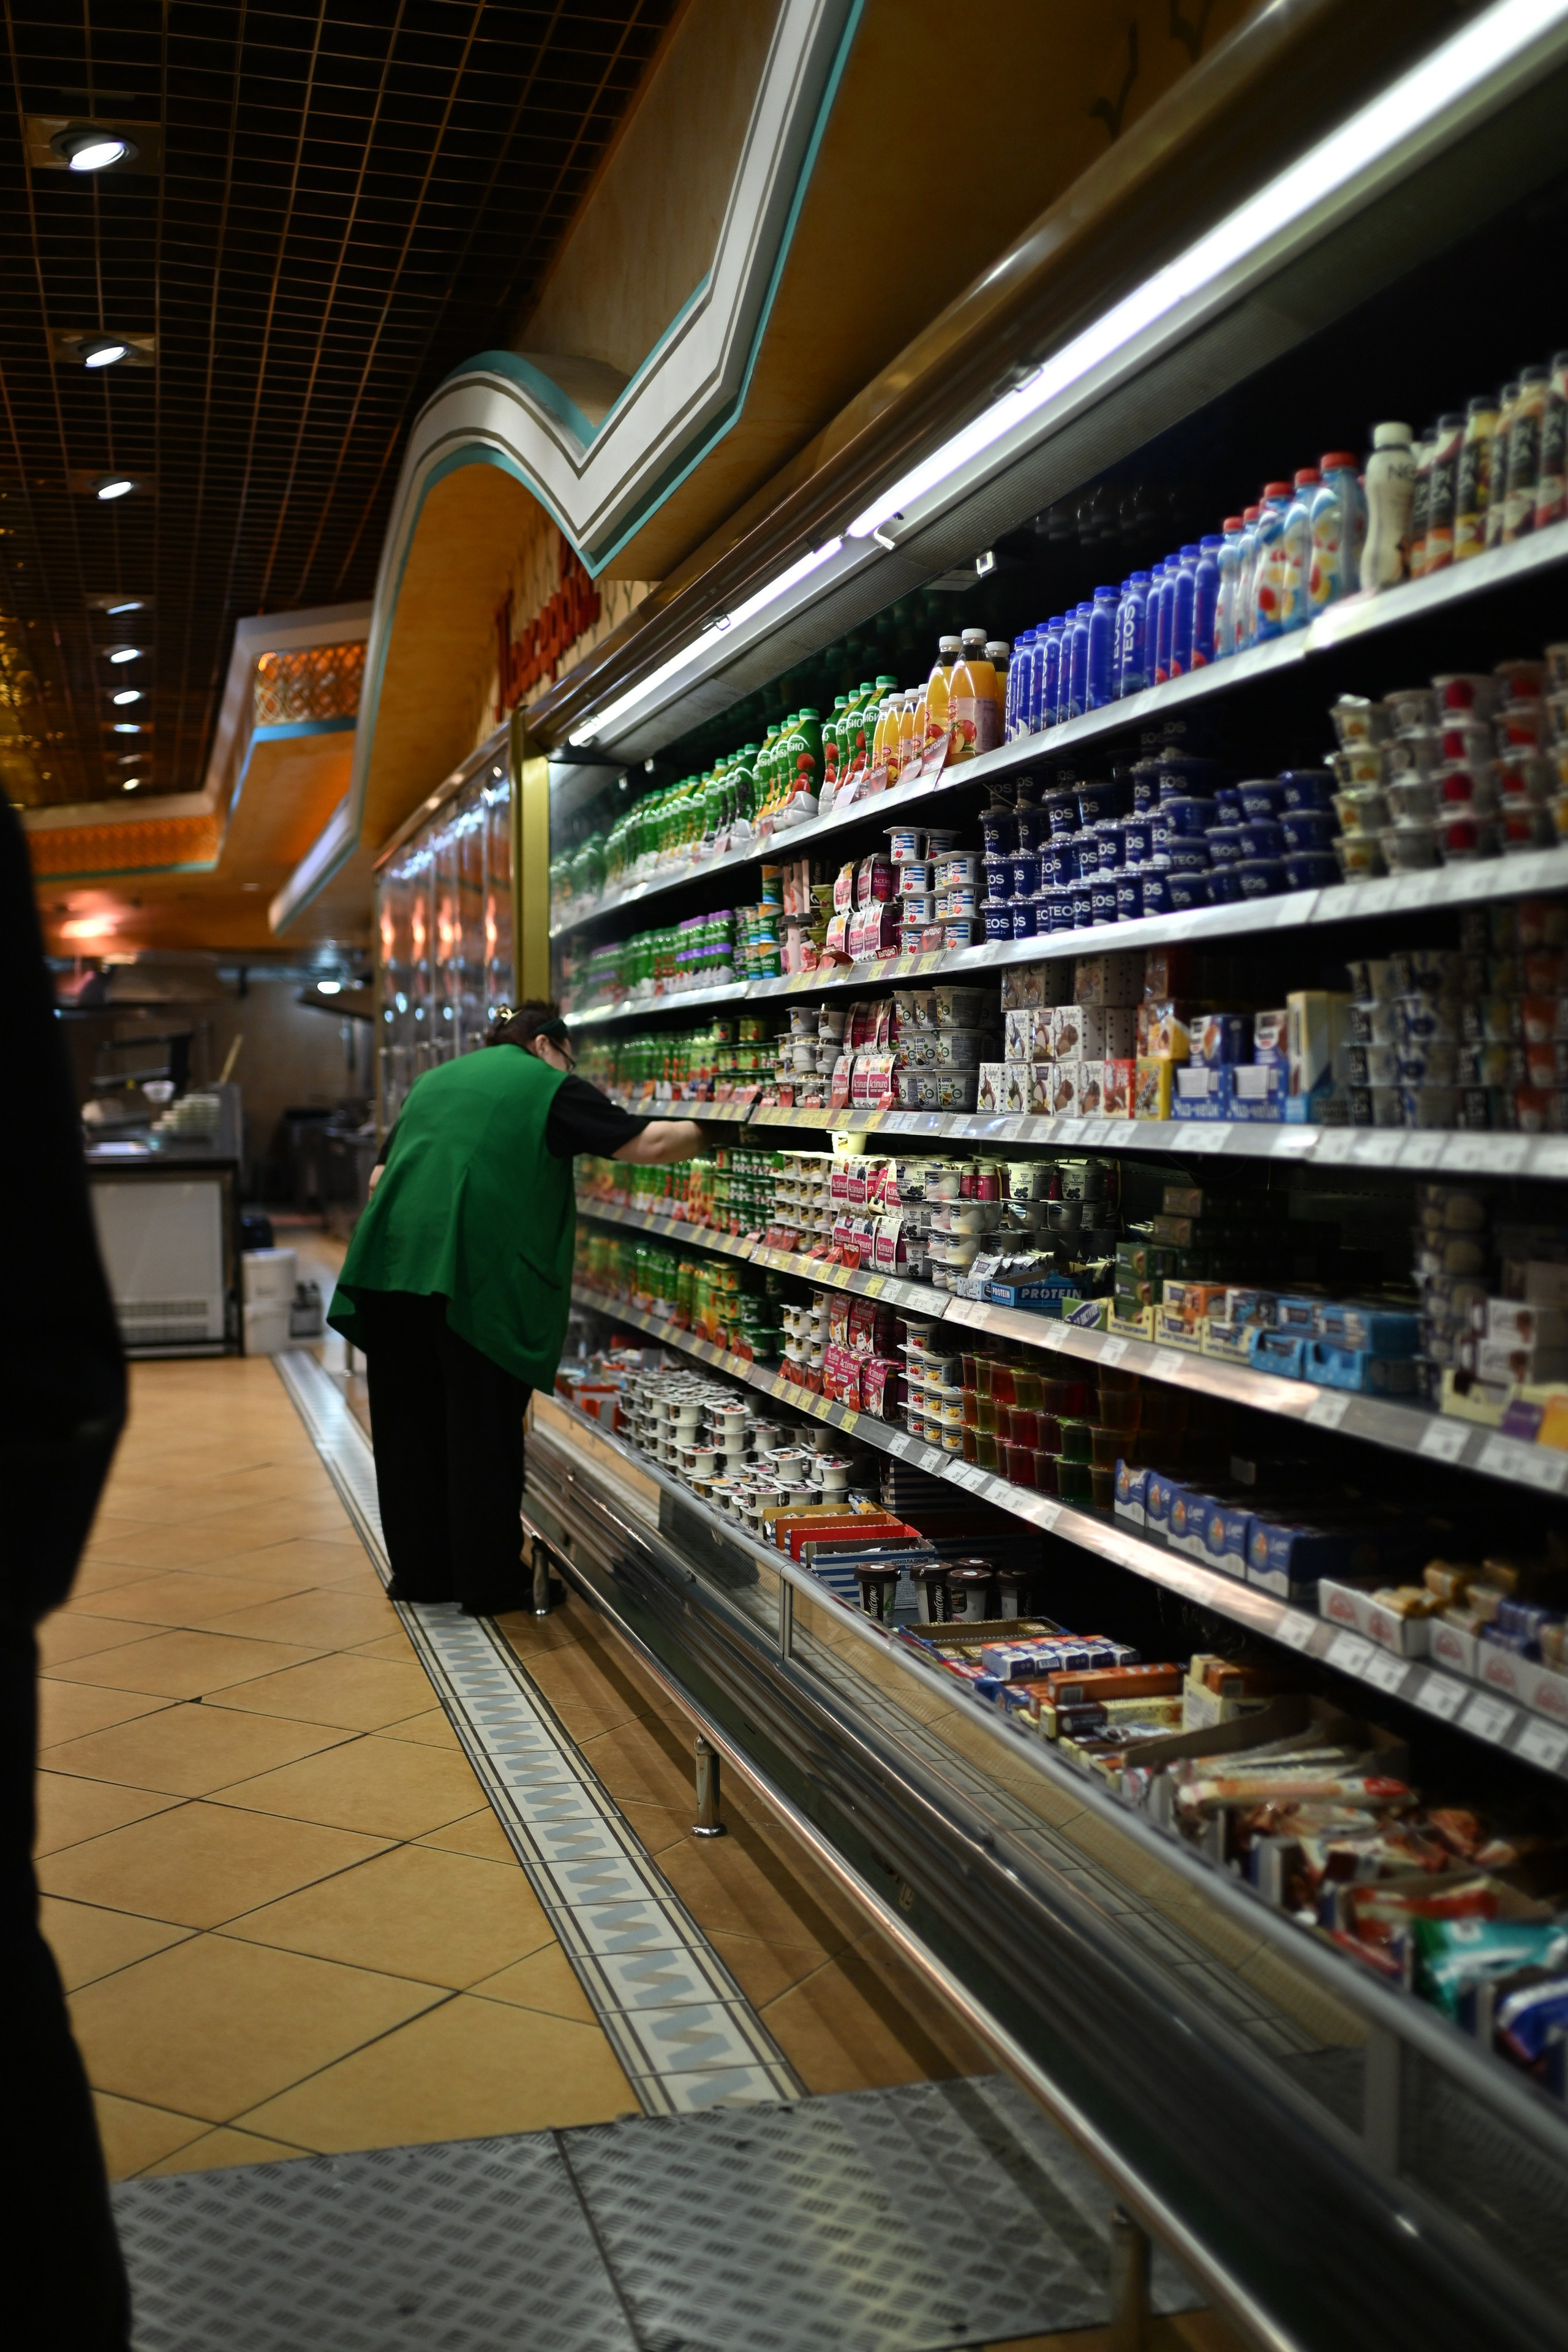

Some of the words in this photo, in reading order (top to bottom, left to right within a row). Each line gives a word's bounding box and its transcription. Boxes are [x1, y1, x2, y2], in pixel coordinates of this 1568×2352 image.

[1123, 603, 1135, 662] TEOS
[924, 735, 947, 757] ВЫГОДНО
[1160, 776, 1188, 788] EOS
[1049, 808, 1074, 819] EOS
[1092, 895, 1115, 907] EOS
[1048, 905, 1074, 917] TEO
[986, 918, 1009, 929] EOS
[1013, 916, 1026, 927] OS
[924, 927, 941, 936] ВЫГОДНО
[878, 949, 895, 958] ВЫГОДНО
[854, 1079, 867, 1088] Actimun
[869, 1079, 888, 1088] Actimuno
[833, 1180, 847, 1189] Actimun
[992, 1286, 1011, 1298] PROTEIN
[1021, 1288, 1083, 1299] PROTEIN
[840, 1358, 859, 1373] Actimuno
[870, 1585, 878, 1618] ниссимо
[933, 1585, 942, 1624] аниссимо
